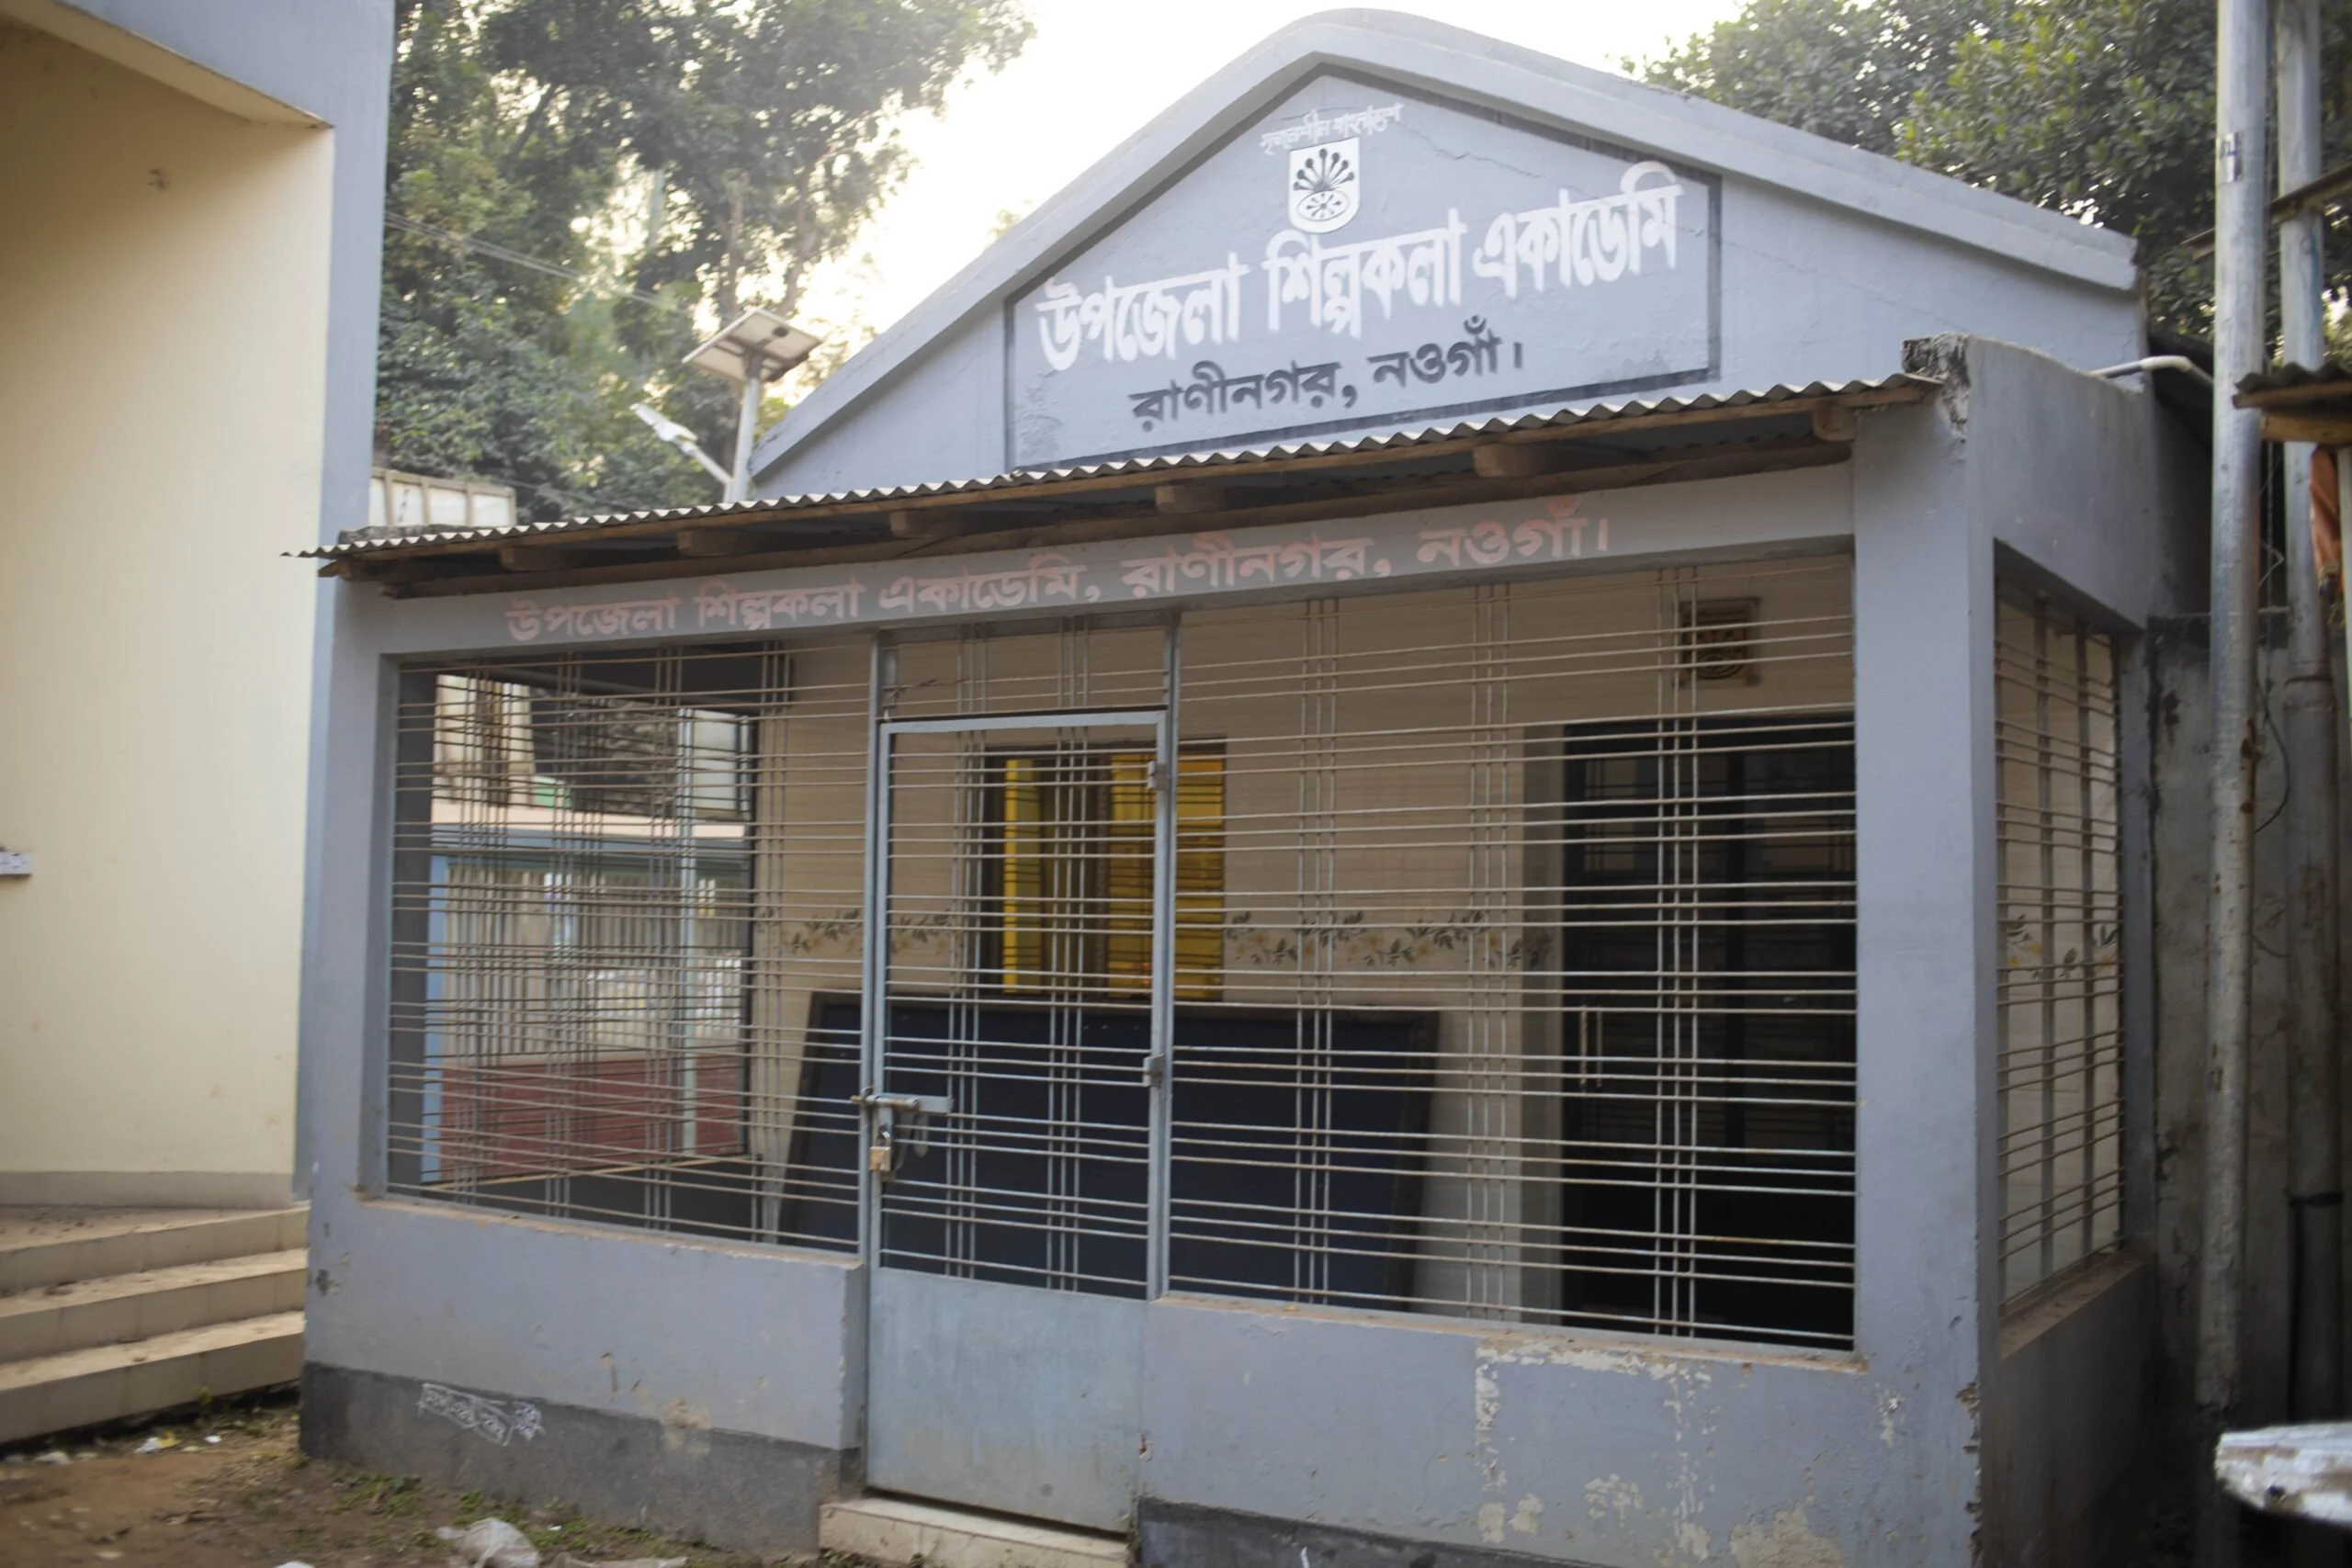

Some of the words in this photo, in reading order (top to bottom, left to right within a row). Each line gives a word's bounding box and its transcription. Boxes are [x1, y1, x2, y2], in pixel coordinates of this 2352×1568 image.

[1036, 253, 1250, 370] উপজেলা
[1263, 209, 1466, 338] শিল্পকলা
[1474, 162, 1683, 299] একাডেমি
[1130, 362, 1357, 432] রাণীনগর,
[505, 590, 681, 640] উপজেলা
[693, 573, 866, 631] শিল্পকলা
[879, 553, 1102, 613] একাডেমি,
[1121, 530, 1393, 597] রাণীনগর,
